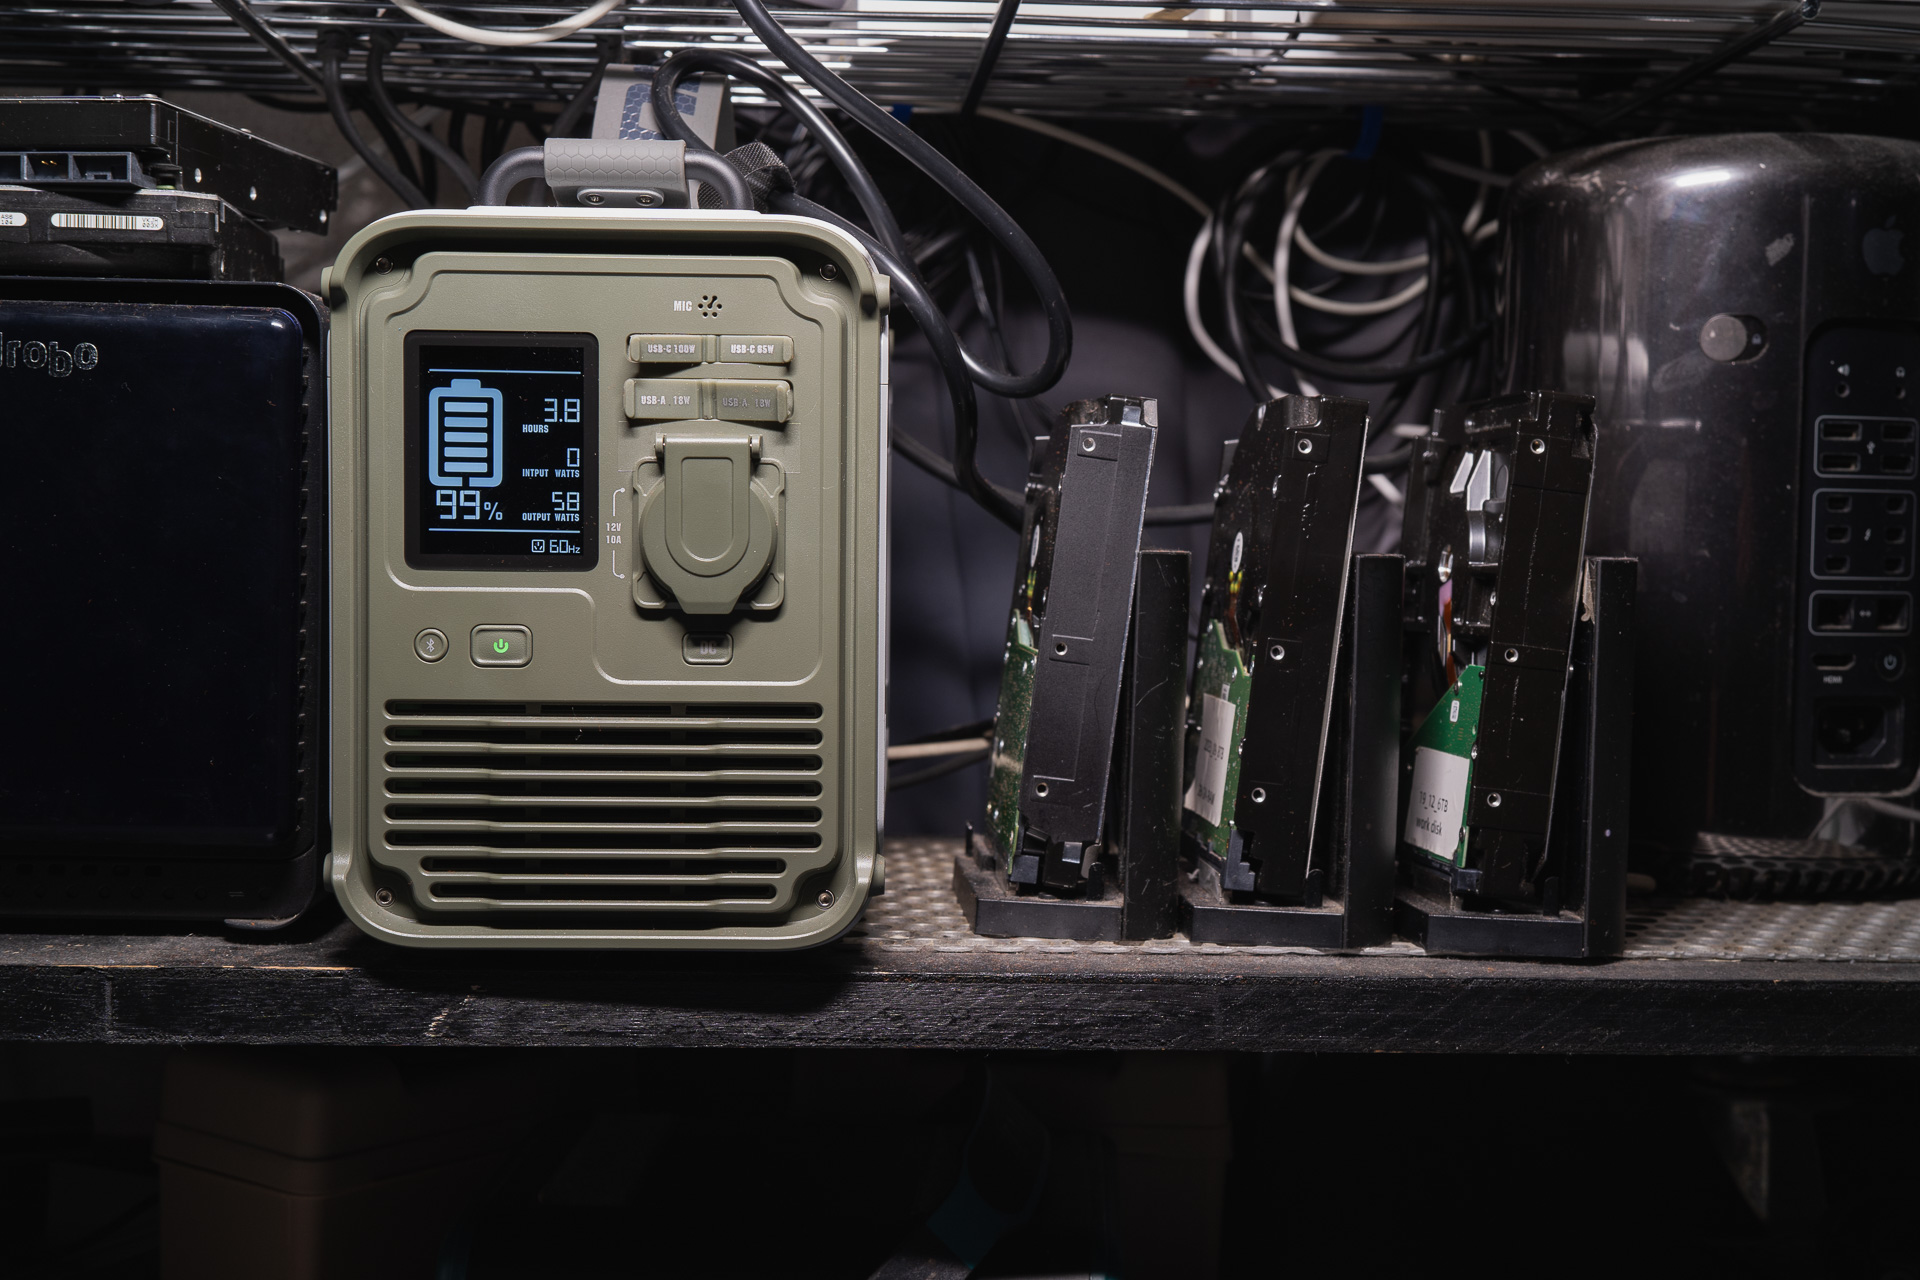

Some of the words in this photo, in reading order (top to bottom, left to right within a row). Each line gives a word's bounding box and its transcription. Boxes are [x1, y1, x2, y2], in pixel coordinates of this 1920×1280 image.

[674, 300, 693, 312] MIC
[647, 344, 672, 354] USB-C
[674, 344, 696, 354] 100W
[731, 344, 755, 354] USB-C
[0, 332, 98, 378] robo
[641, 395, 666, 405] USB-A
[673, 395, 691, 405] 18W
[722, 397, 748, 408] USB-A
[755, 398, 771, 408] 18W
[544, 398, 581, 423] 3.8
[522, 424, 549, 433] HOURS
[566, 447, 580, 467] 0
[522, 469, 549, 478] INTPUT
[554, 469, 580, 478] WATTS
[552, 491, 580, 511] 58
[522, 512, 551, 522] OUTPUT
[554, 513, 580, 522] WATTS
[606, 522, 622, 532] 12V
[606, 535, 622, 544] 10A
[700, 641, 717, 655] DC
[1823, 675, 1843, 684] HDMI
[1416, 816, 1431, 832] work
[1430, 819, 1443, 836] disk
